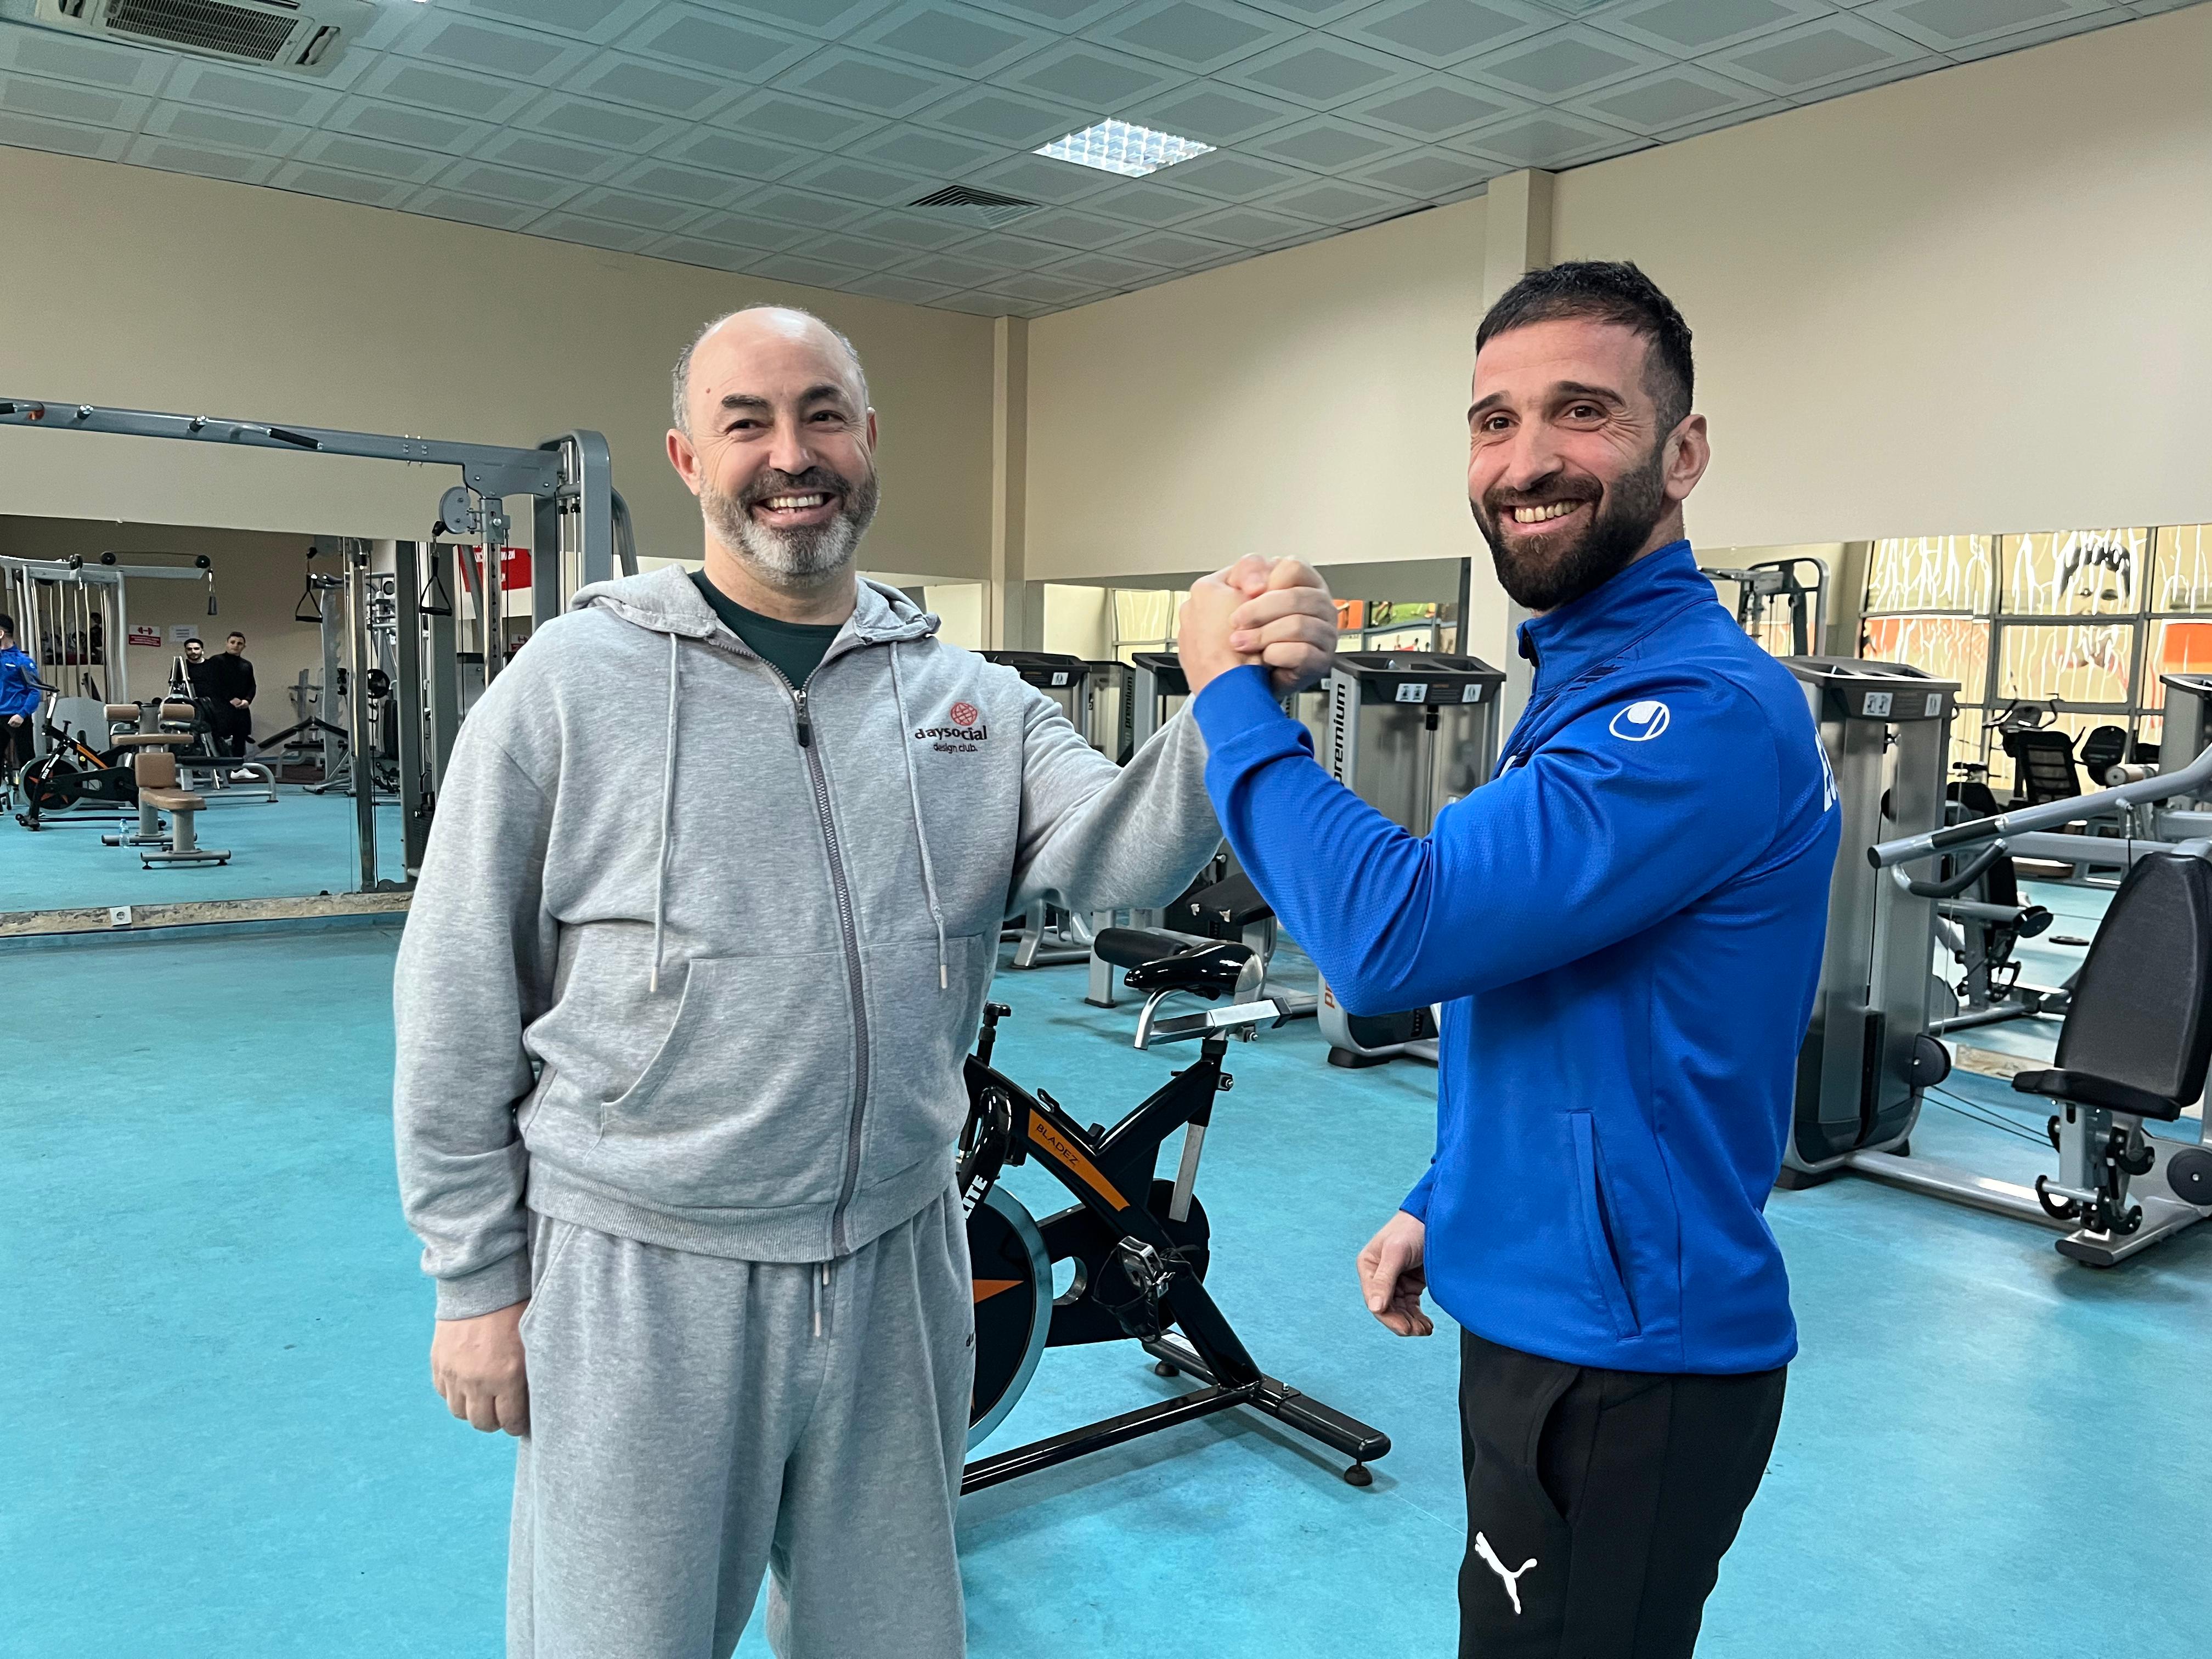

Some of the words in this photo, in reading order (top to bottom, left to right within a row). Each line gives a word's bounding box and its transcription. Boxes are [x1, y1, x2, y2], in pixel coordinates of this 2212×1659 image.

[915, 725, 988, 741] daysocial
[933, 742, 957, 754] design
[1036, 1124, 1079, 1165] BLADEZ
